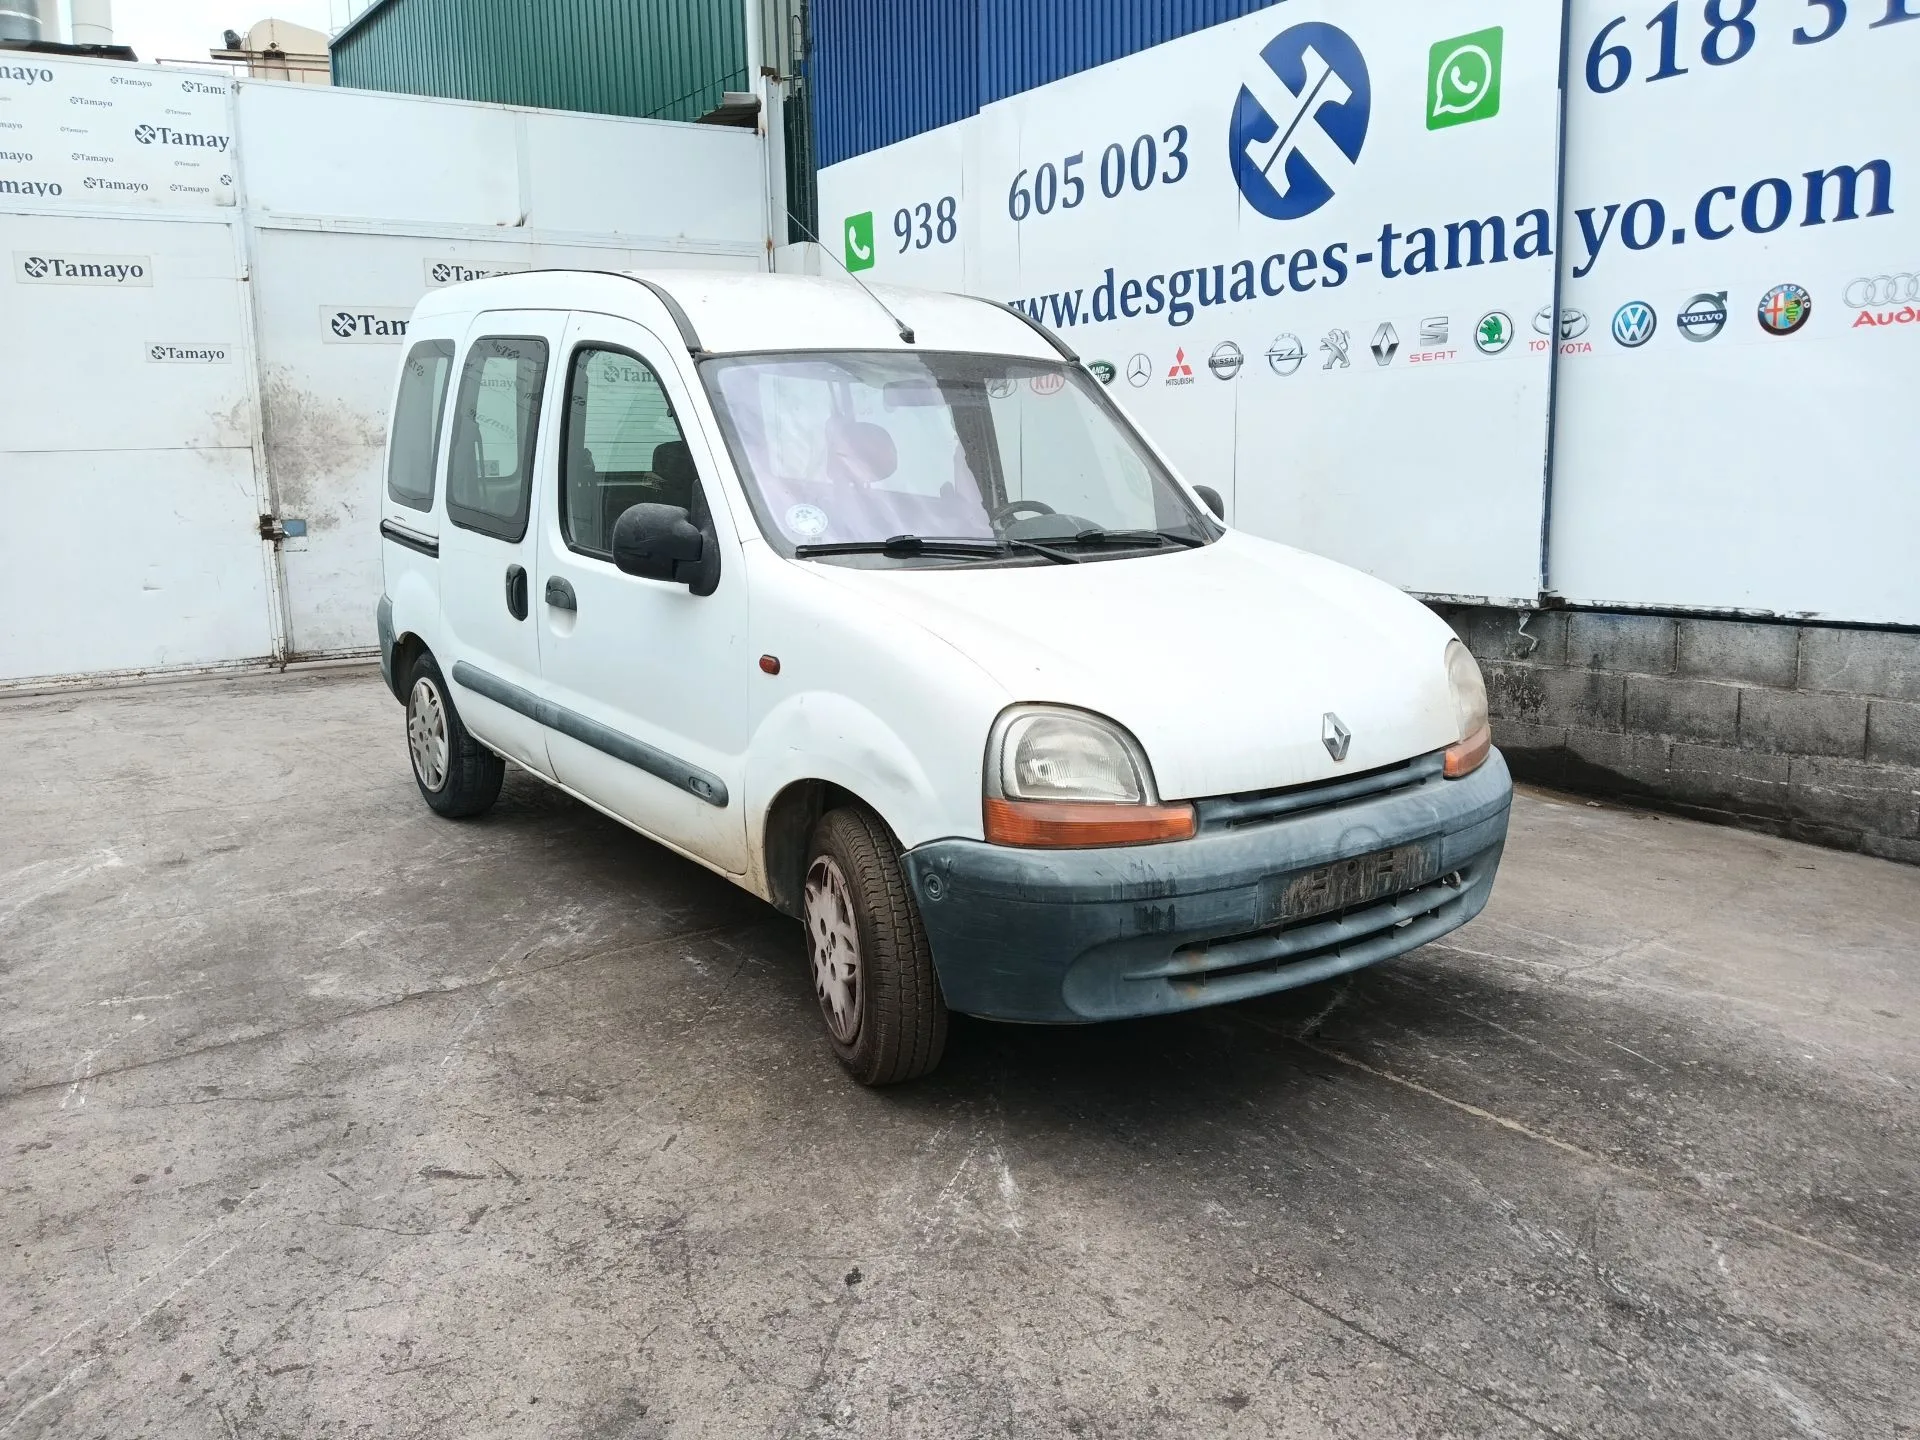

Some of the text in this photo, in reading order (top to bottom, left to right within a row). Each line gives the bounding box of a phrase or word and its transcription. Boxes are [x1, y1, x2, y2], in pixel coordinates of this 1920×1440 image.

[118, 77, 152, 88] Tamayo
[78, 97, 113, 108] Tamayo
[893, 196, 957, 254] 938
[1008, 150, 1084, 222] 605
[1100, 124, 1189, 199] 003
[1585, 0, 1756, 94] 618
[80, 153, 114, 163] Tamayo
[96, 178, 149, 193] Tamayo
[178, 184, 210, 194] Tamayo
[49, 259, 144, 282] Tamayo
[1680, 313, 1724, 323] VOLVO
[165, 347, 225, 362] Tamayo
[1409, 350, 1457, 363] SEAT
[1211, 356, 1242, 366] NISSAN
[1166, 377, 1194, 387] MITSUBISHI
